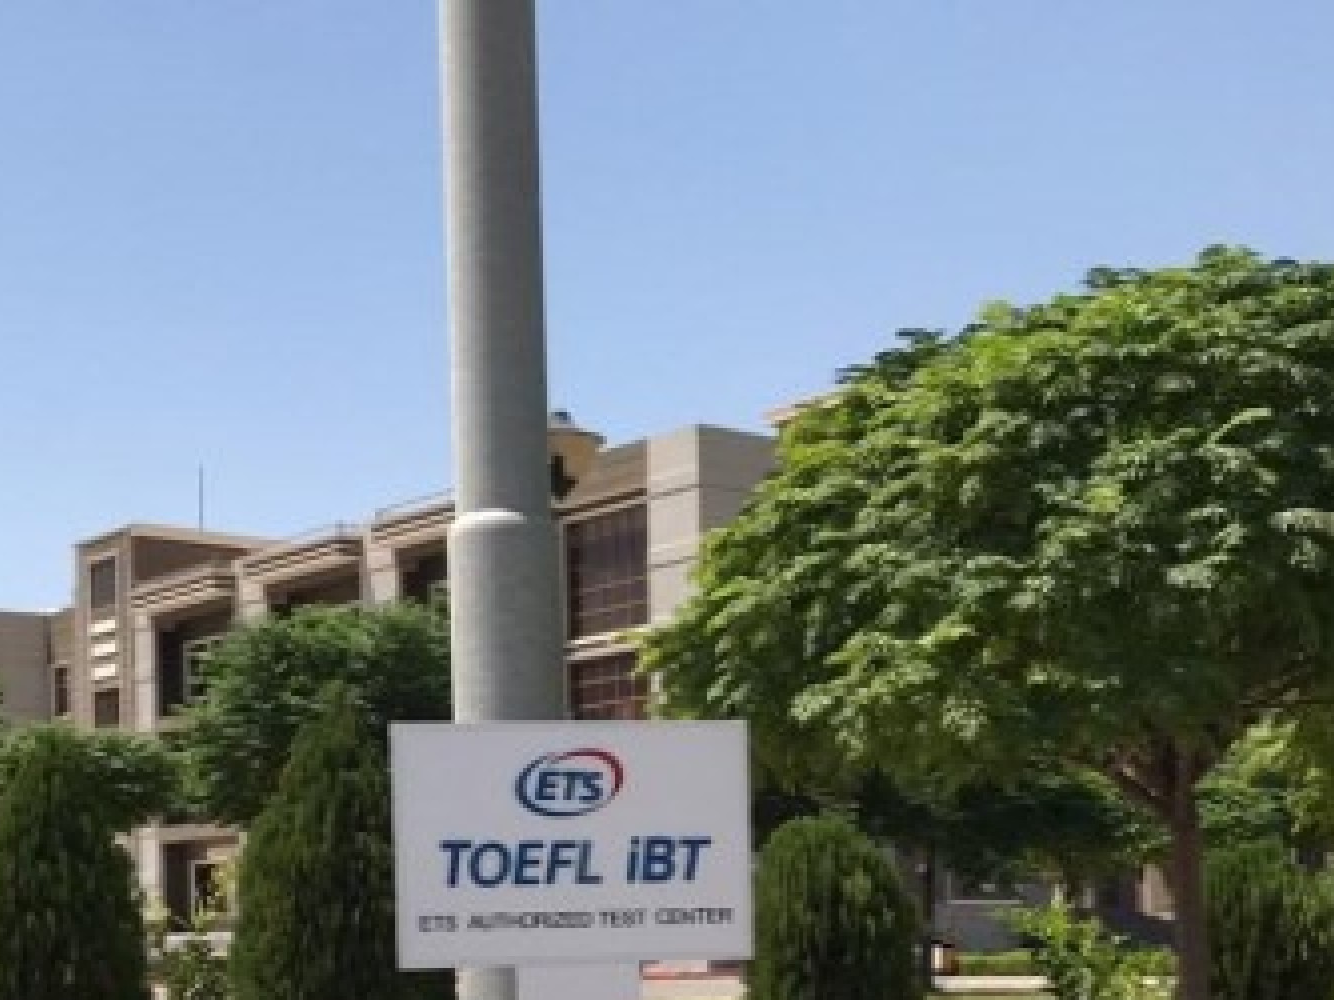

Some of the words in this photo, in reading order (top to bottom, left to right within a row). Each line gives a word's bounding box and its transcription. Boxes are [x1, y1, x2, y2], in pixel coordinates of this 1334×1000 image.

[534, 770, 604, 803] ETS
[439, 838, 604, 888] TOEFL
[626, 835, 712, 884] iBT
[418, 914, 457, 932] ETS
[467, 911, 595, 930] AUTHORIZED
[599, 908, 647, 928] TEST
[655, 906, 735, 926] CENTER
